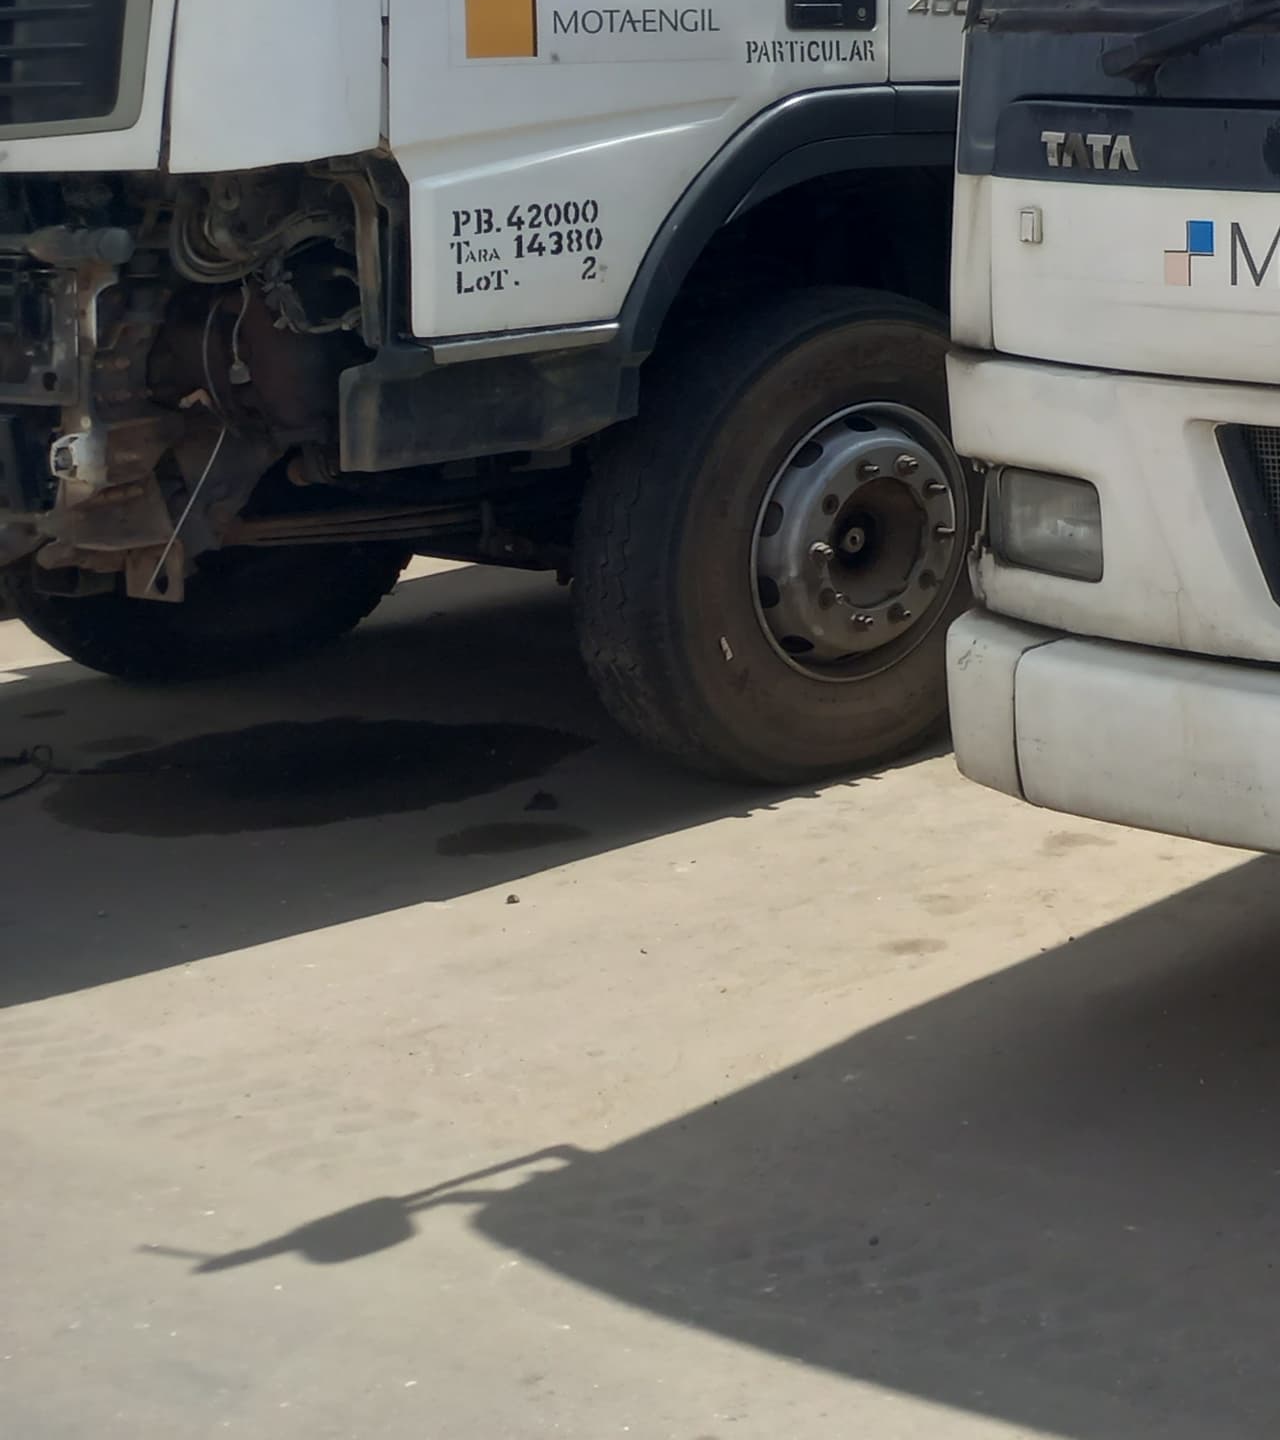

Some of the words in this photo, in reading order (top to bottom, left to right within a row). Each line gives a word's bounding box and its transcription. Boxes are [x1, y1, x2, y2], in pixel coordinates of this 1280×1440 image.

[1039, 129, 1140, 172] TATA
[513, 227, 603, 259] 14380
[581, 255, 597, 280] 2
